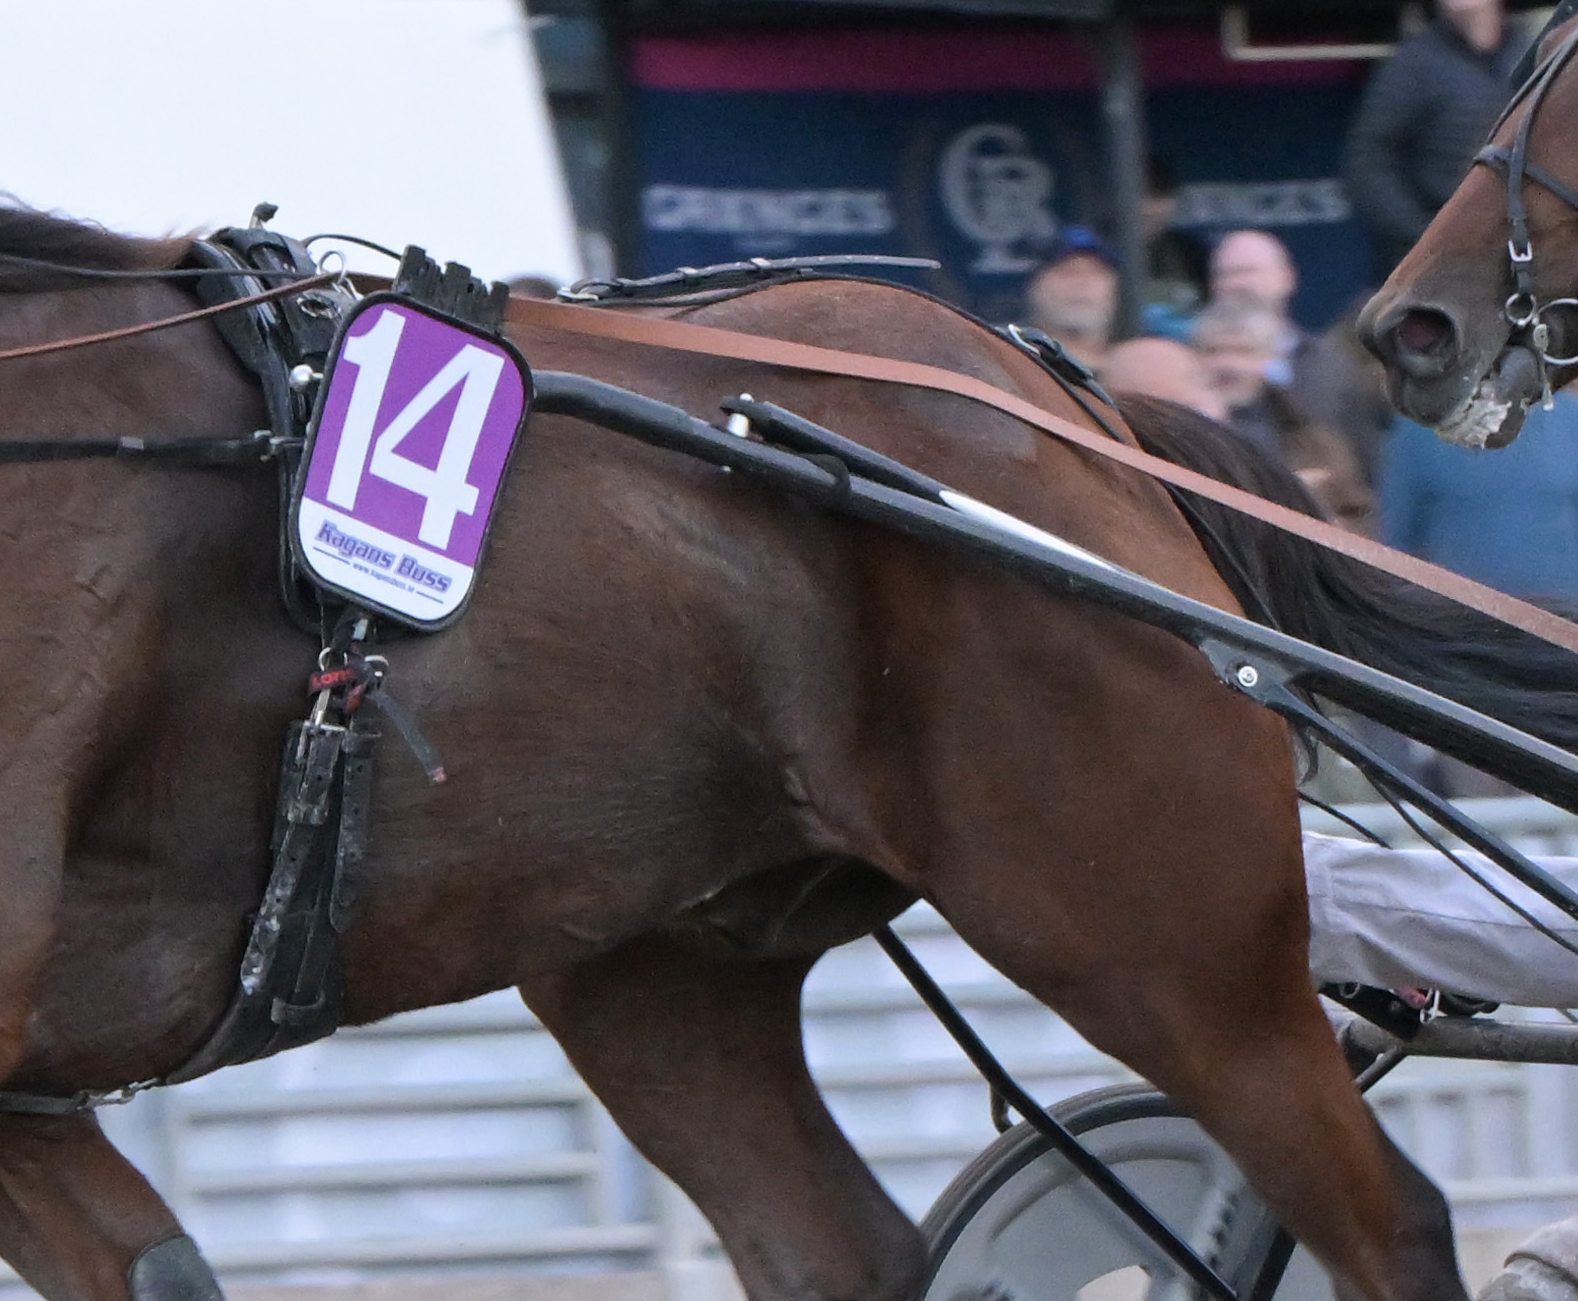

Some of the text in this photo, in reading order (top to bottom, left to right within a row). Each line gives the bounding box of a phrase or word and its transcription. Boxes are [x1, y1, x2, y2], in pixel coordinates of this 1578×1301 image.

[327, 308, 505, 551] 14
[315, 520, 453, 594] Kagans Buss
